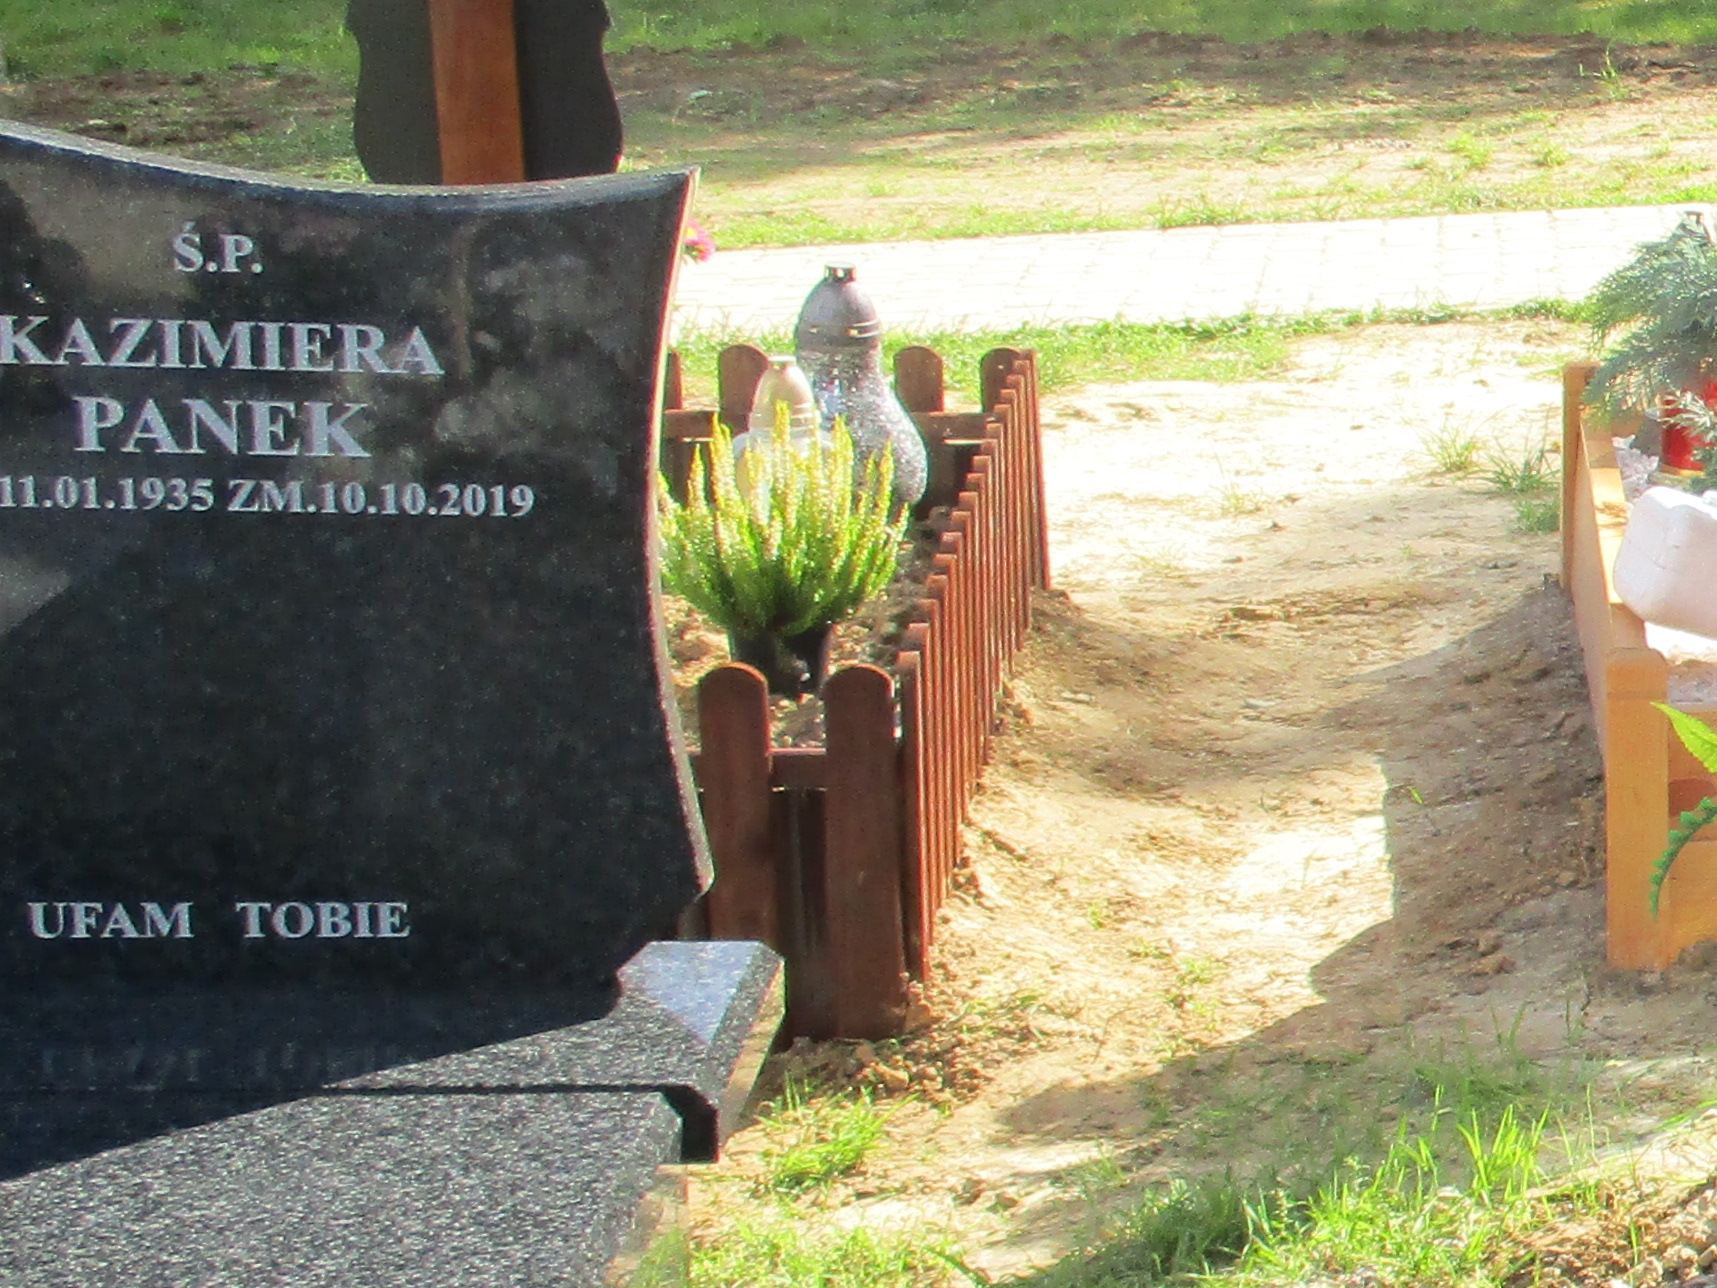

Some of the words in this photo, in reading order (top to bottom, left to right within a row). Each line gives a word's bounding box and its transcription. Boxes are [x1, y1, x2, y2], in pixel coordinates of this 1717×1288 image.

[173, 221, 263, 274] Ś.P.
[0, 315, 446, 375] KAZIMIERA
[72, 395, 372, 458] PANEK
[0, 475, 215, 512] 11.01.1935
[227, 478, 535, 517] ZM.10.10.2019
[27, 902, 195, 939] UFAM
[236, 902, 411, 939] TOBIE
